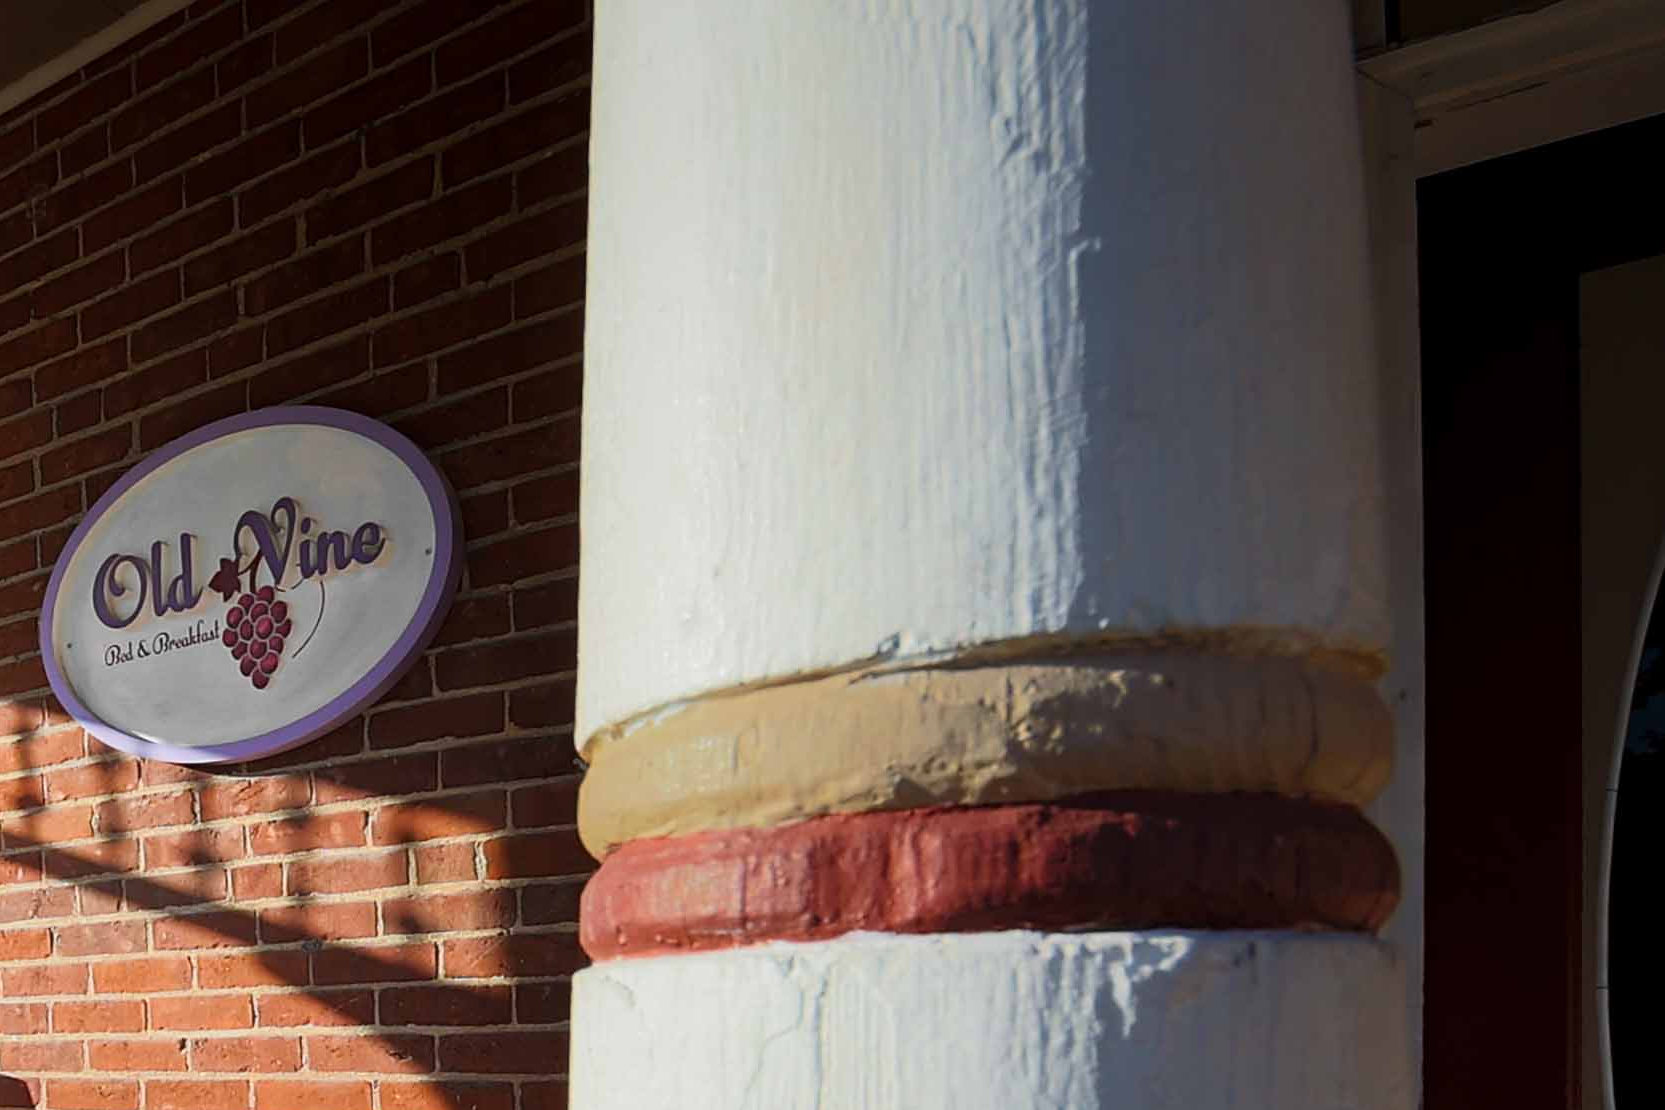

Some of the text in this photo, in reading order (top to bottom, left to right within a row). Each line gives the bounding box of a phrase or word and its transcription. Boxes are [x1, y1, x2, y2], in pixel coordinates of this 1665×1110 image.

[92, 496, 387, 629] Old Vine
[104, 619, 220, 666] Bed & Breakfast
